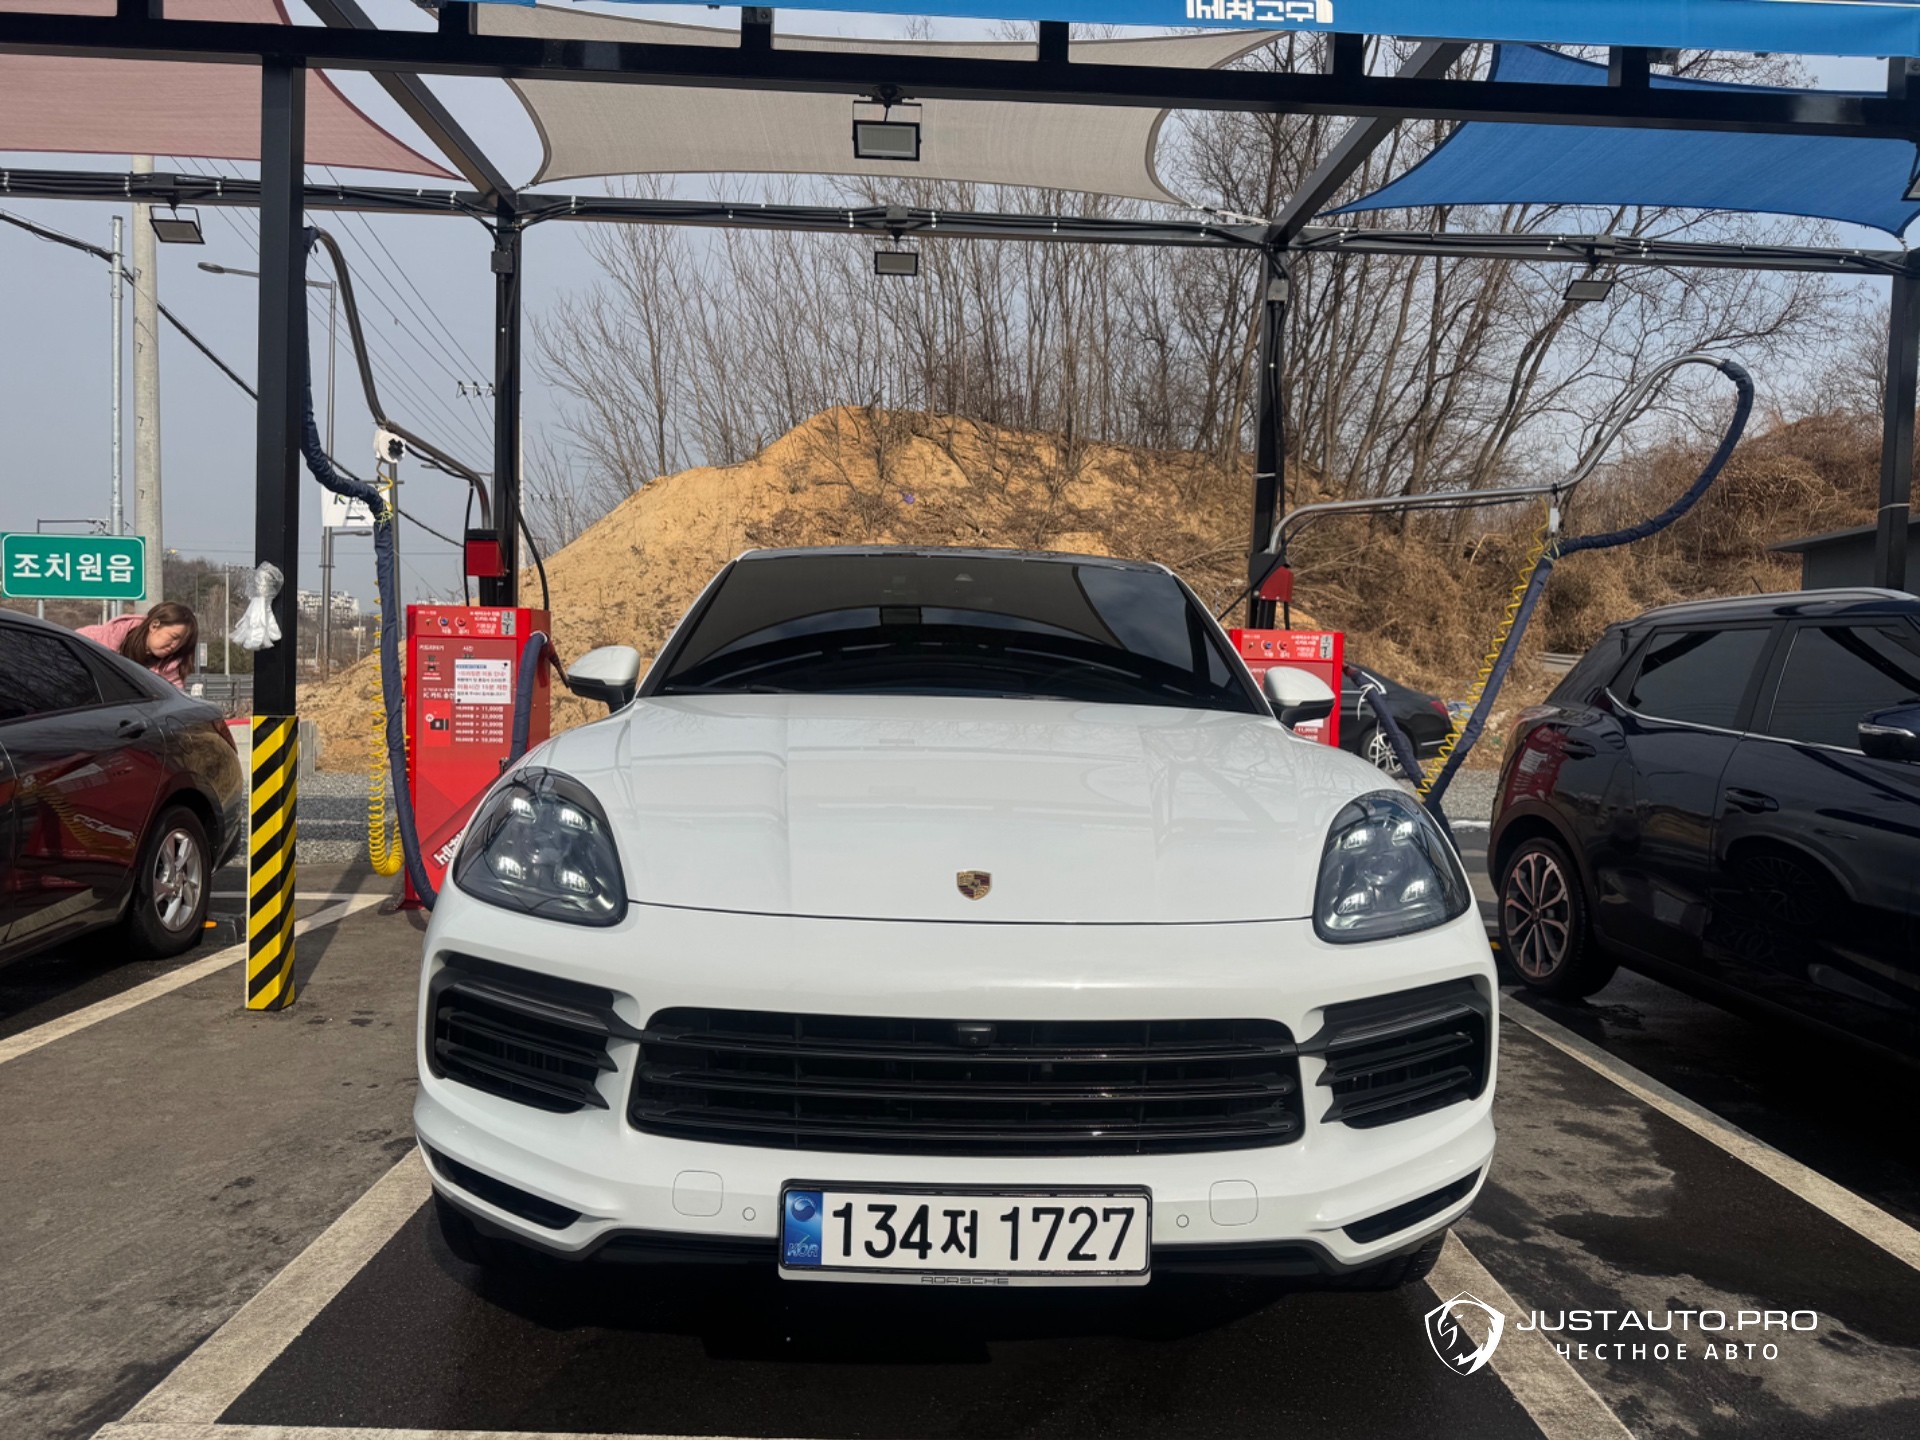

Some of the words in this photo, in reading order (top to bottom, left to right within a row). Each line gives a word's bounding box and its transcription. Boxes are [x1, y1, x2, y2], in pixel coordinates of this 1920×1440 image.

[13, 552, 135, 583] 조치원읍
[833, 1201, 978, 1260] 134저
[1000, 1205, 1135, 1261] 1727
